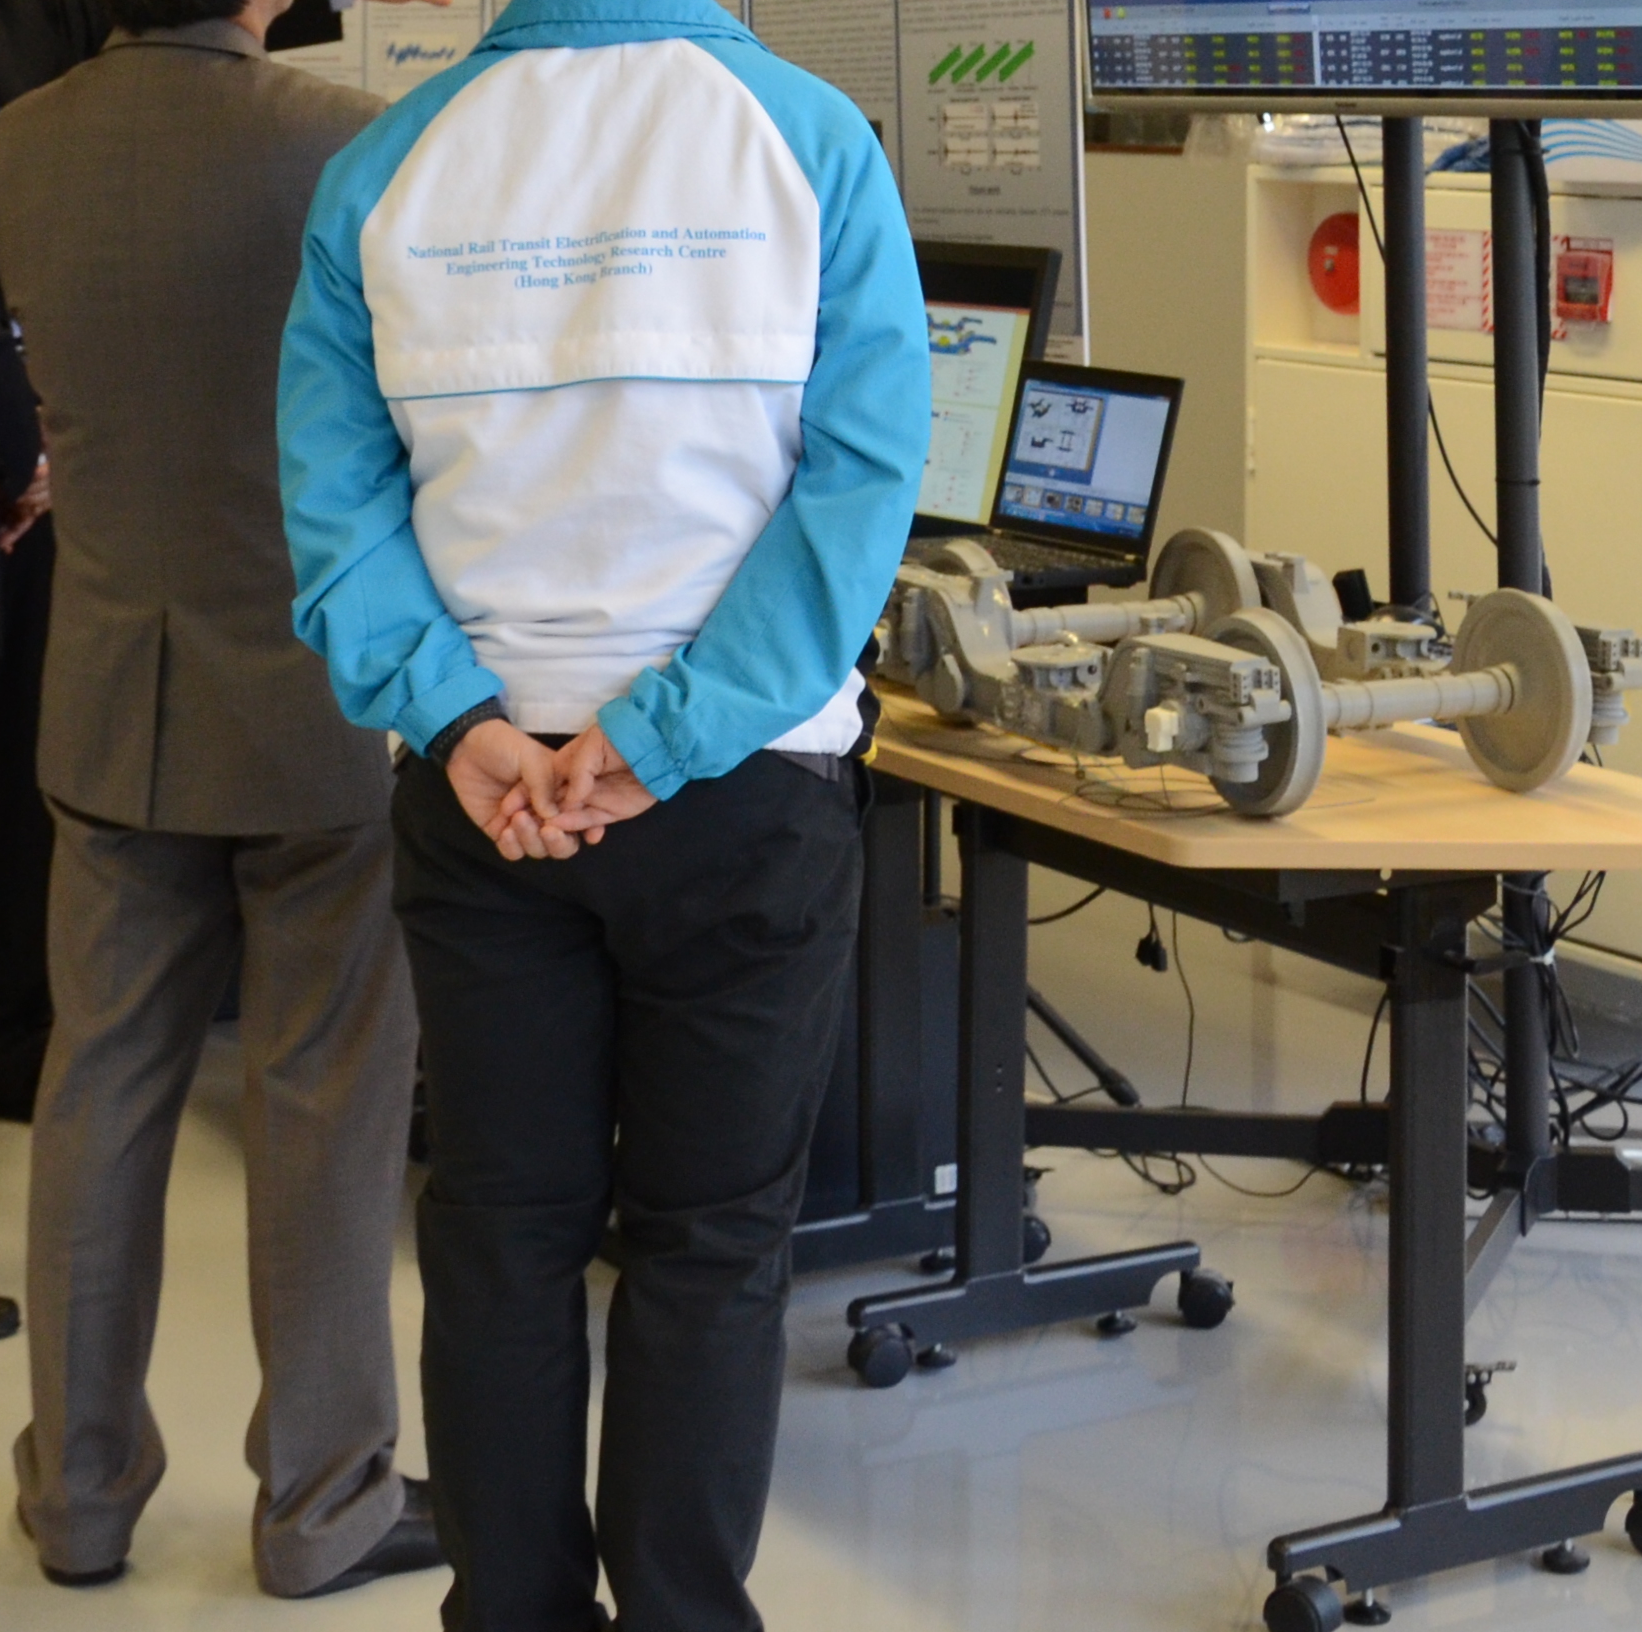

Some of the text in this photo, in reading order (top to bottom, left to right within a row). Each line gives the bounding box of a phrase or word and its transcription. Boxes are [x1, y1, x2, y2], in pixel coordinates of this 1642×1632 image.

[407, 226, 766, 260] National Rail Transit Electrification and Automation
[446, 243, 726, 277] Engineering Technology Research Centre
[514, 263, 653, 290] (Hong Kong Branch)
